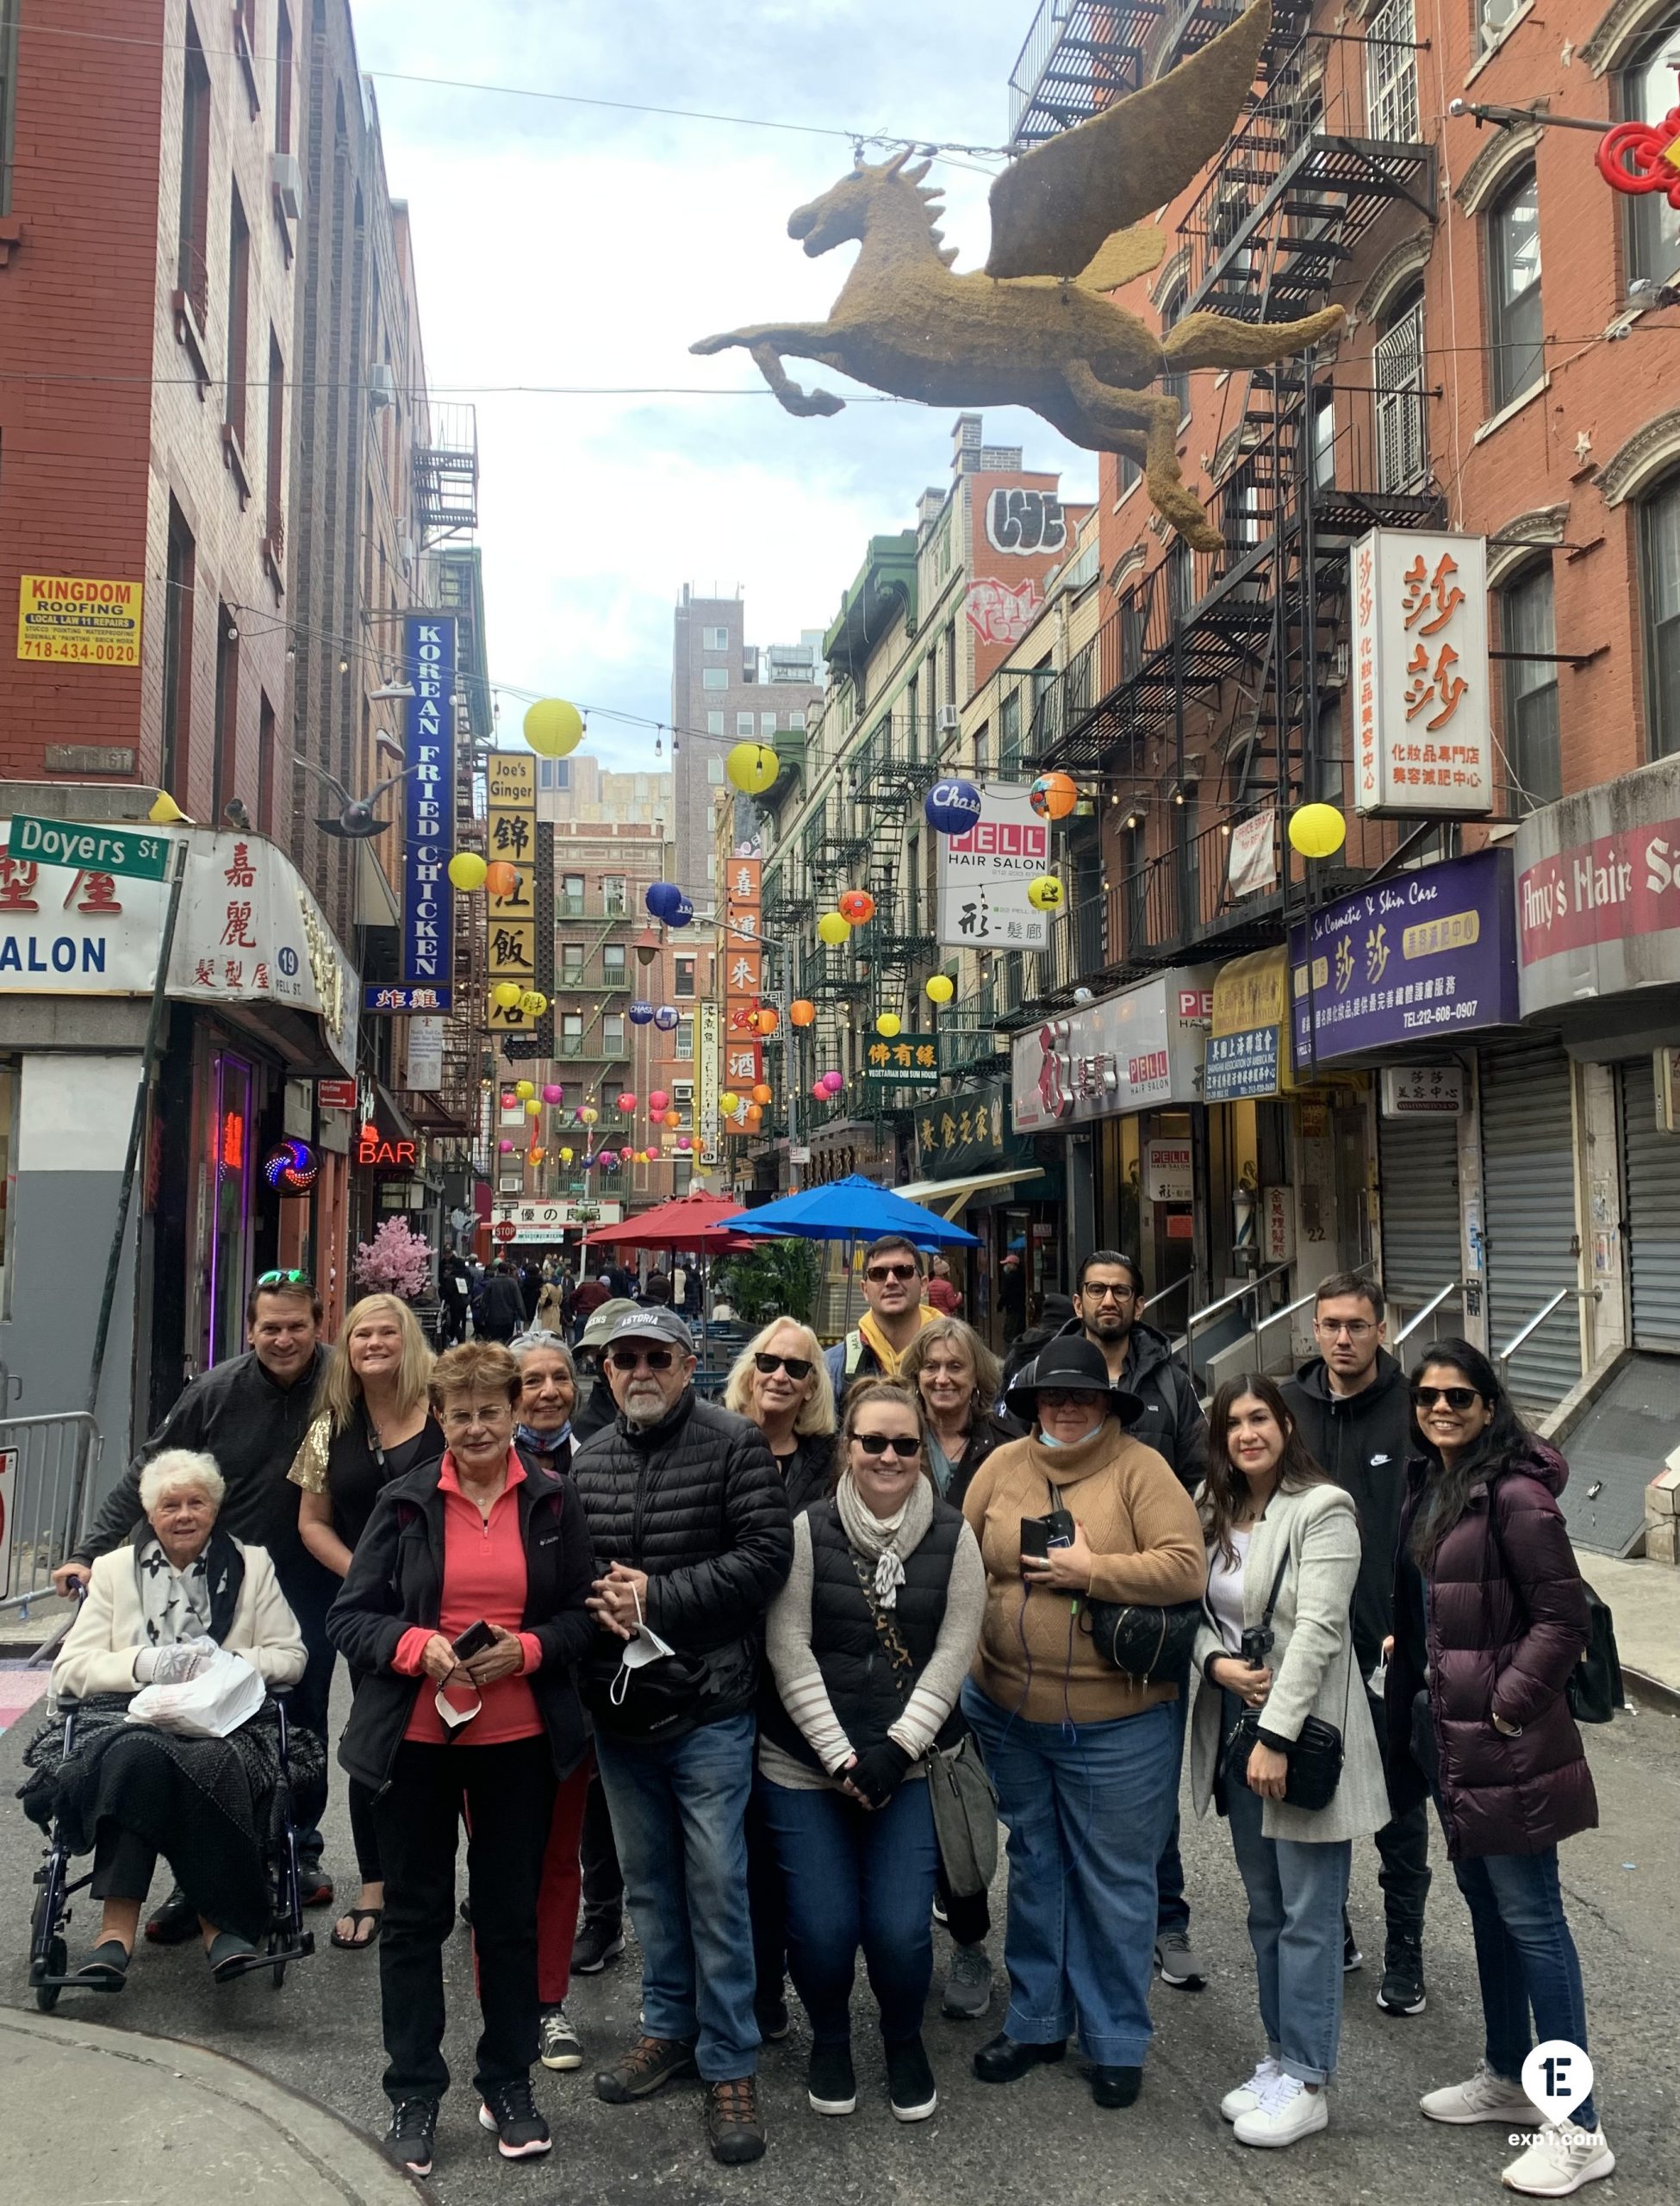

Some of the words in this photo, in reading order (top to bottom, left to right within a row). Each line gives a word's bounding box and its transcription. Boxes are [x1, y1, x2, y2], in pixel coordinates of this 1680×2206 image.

[32, 580, 131, 603] KINGDOM
[37, 601, 124, 615] ROOFING
[30, 614, 59, 625] LOCAL
[60, 615, 78, 626] LAW
[81, 617, 91, 626] 11
[93, 617, 129, 627] REPAIRS
[24, 641, 134, 662] 718-434-0020
[417, 625, 442, 735] KOREAN
[496, 761, 527, 777] Joe's
[415, 745, 442, 837] FRIED
[490, 781, 532, 801] Ginger
[933, 785, 980, 814] Chase
[21, 820, 126, 863] Doyers
[138, 839, 159, 859] St
[950, 824, 1045, 856] PELL
[949, 854, 986, 866] HAIR
[993, 857, 1045, 870] SALON
[220, 842, 257, 948] 嘉麗
[1523, 868, 1568, 931] Amy's
[1573, 851, 1633, 913] Hair
[414, 844, 440, 975] CHICKEN
[1325, 906, 1361, 935] Cosmetic
[1366, 896, 1376, 916] &
[1379, 890, 1405, 914] Skin
[1409, 882, 1438, 905] Care
[282, 950, 295, 973] 19
[276, 979, 290, 994] PELL
[376, 989, 440, 1008] 炸雞
[630, 1006, 653, 1014] CHASE
[868, 1042, 937, 1069] 佛有緣
[1129, 1052, 1168, 1082] PELL
[1130, 1082, 1145, 1095] HAIR
[1148, 1078, 1169, 1090] SALON
[360, 1142, 414, 1163] BAR
[1153, 1152, 1189, 1162] PELL
[496, 1227, 515, 1236] STOP
[1308, 1228, 1326, 1242] 22
[622, 1314, 658, 1326] ASTORIA
